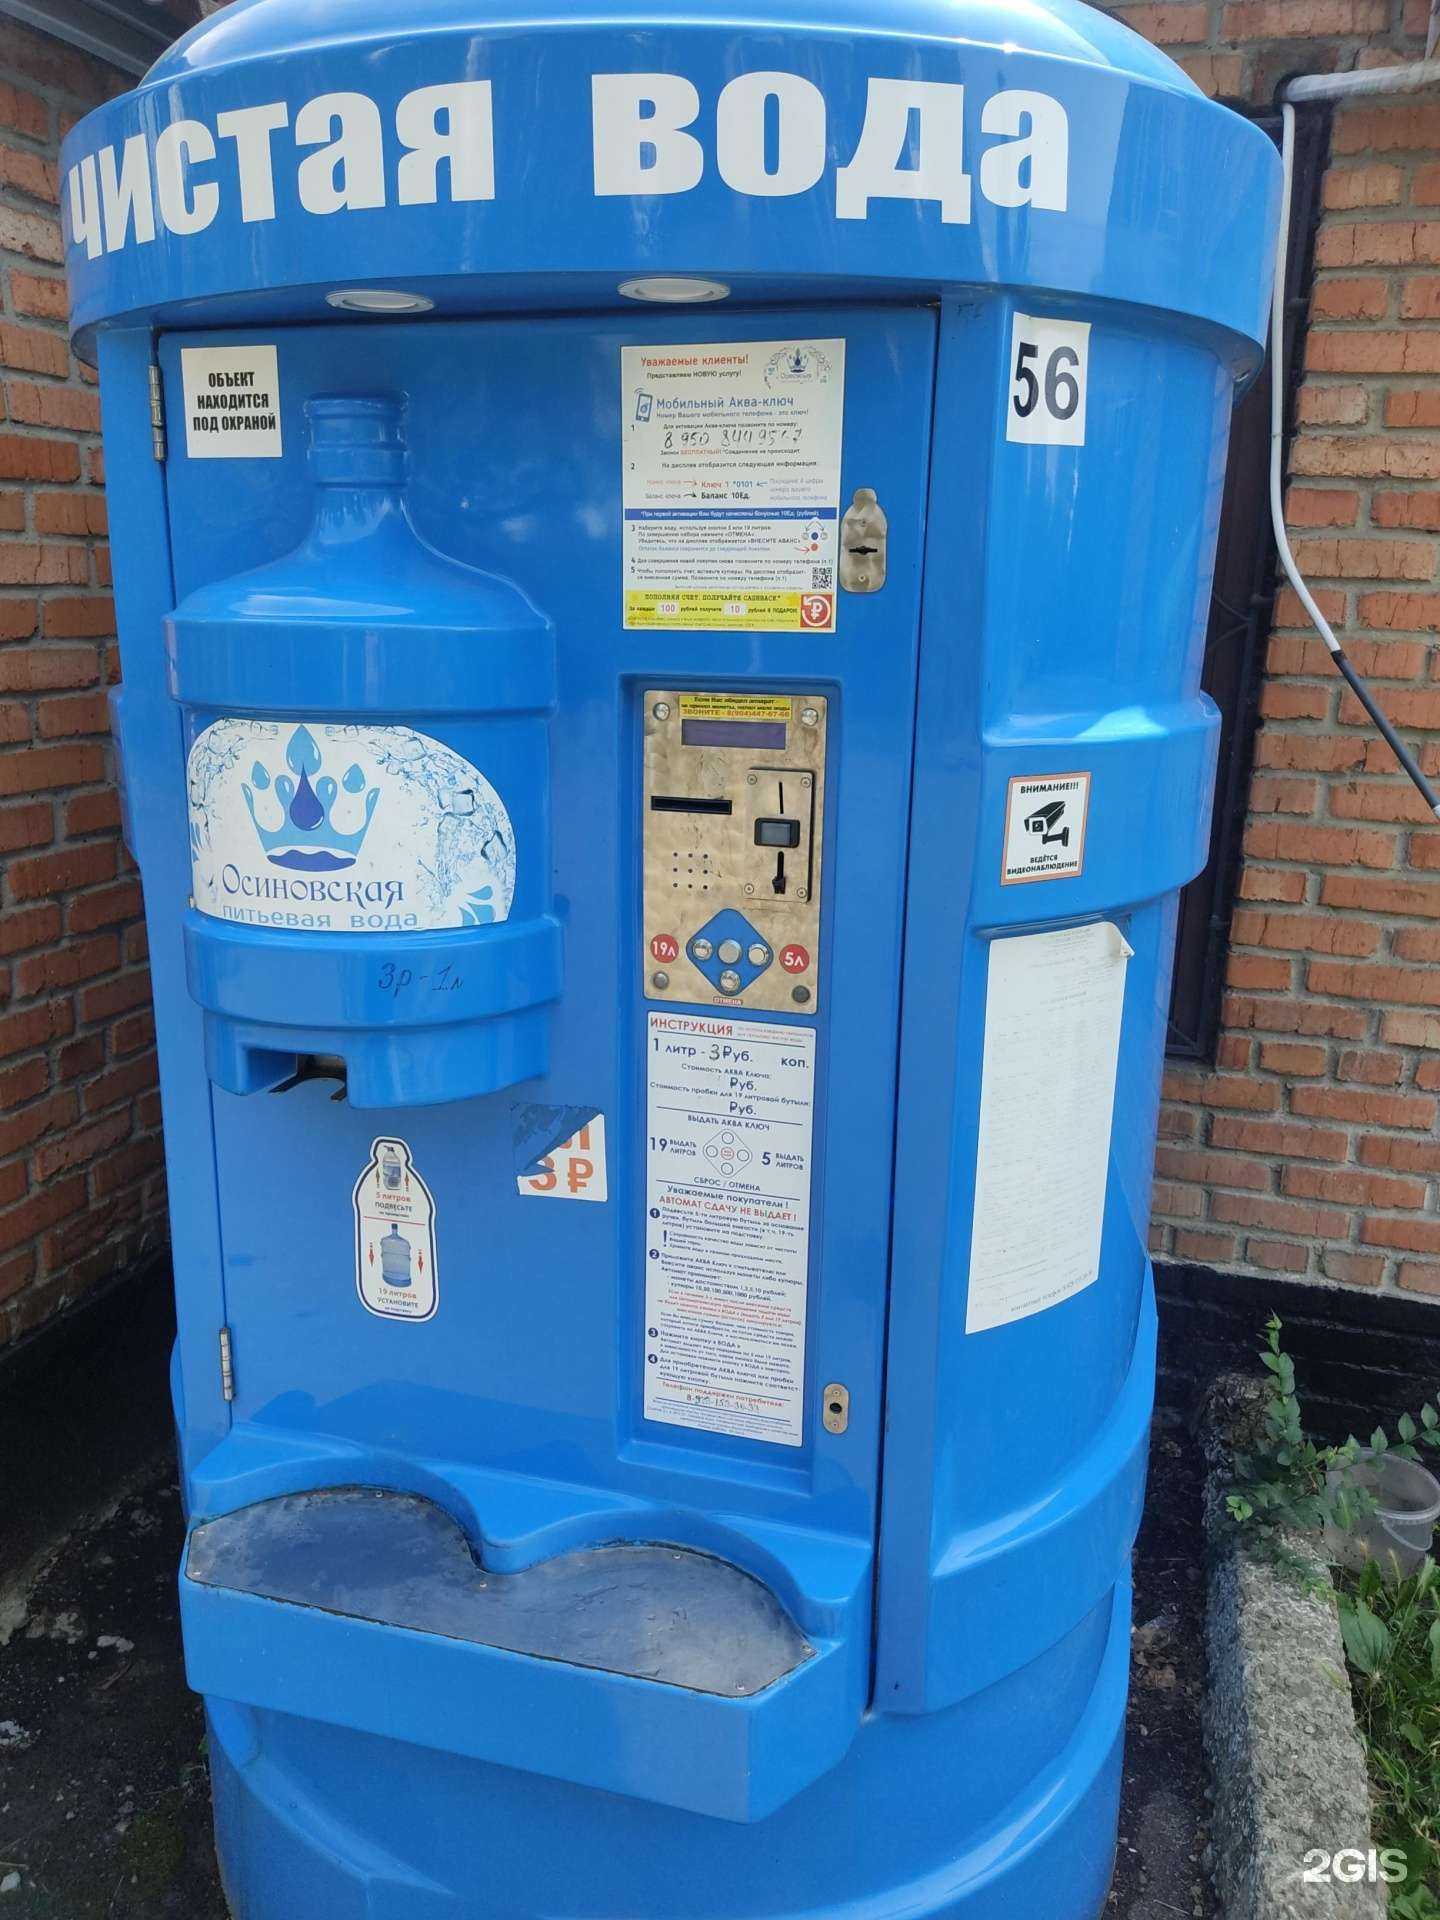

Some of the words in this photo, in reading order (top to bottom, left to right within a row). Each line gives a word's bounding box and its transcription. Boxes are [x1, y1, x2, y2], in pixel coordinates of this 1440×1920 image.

[68, 79, 496, 260] чистая
[591, 71, 1069, 224] вода
[640, 356, 698, 367] Уважаемые
[702, 353, 750, 365] клиенты!
[208, 372, 255, 388] ОБЪЕКТ
[1013, 341, 1080, 421] 56
[197, 393, 269, 411] НАХОДИТСЯ
[656, 396, 724, 410] Мобильный
[730, 397, 794, 408] Аква-ключ
[193, 416, 219, 433] ПОД
[221, 412, 276, 431] ОХРАНОЙ
[661, 604, 676, 613] 100
[730, 604, 740, 613] 10
[1020, 782, 1079, 794] ВНИМАНИЕ!!!
[1007, 860, 1078, 875] ВИДЕОНАБЛЮДЕНИЕ
[222, 863, 404, 910] Осиновская
[223, 905, 331, 928] питьевая
[351, 912, 418, 931] вода
[651, 1017, 733, 1036] ИНСТРУКЦИЯ
[653, 1038, 659, 1051] 1
[666, 1044, 696, 1057] литр
[709, 1044, 720, 1061] 3
[781, 1057, 809, 1069] коп.
[682, 1063, 722, 1074] Стоимость
[650, 1082, 690, 1092] Стоимость
[688, 1115, 719, 1125] ВЫДАТЬ
[722, 1120, 742, 1128] АКВА
[745, 1122, 769, 1131] КЛЮЧ
[651, 1137, 667, 1151] 19
[670, 1140, 696, 1148] ВЫДАТЬ
[670, 1147, 696, 1156] ЛИТРОВ
[762, 1152, 771, 1165] 5
[776, 1152, 804, 1162] ВЫДАТЬ
[776, 1162, 803, 1170] ЛИТРОВ
[694, 1177, 721, 1187] СБРОС
[729, 1181, 760, 1192] ОТМЕНА
[667, 1185, 724, 1200] Уважаемые
[727, 1194, 783, 1209] покупатели
[659, 1196, 701, 1208] АВТОМАТ
[704, 1201, 737, 1214] СДАЧУ
[740, 1205, 751, 1214] НЕ
[754, 1208, 791, 1220] ВЫДАЕТ
[377, 1296, 418, 1308] УСТАНОВИТЕ
